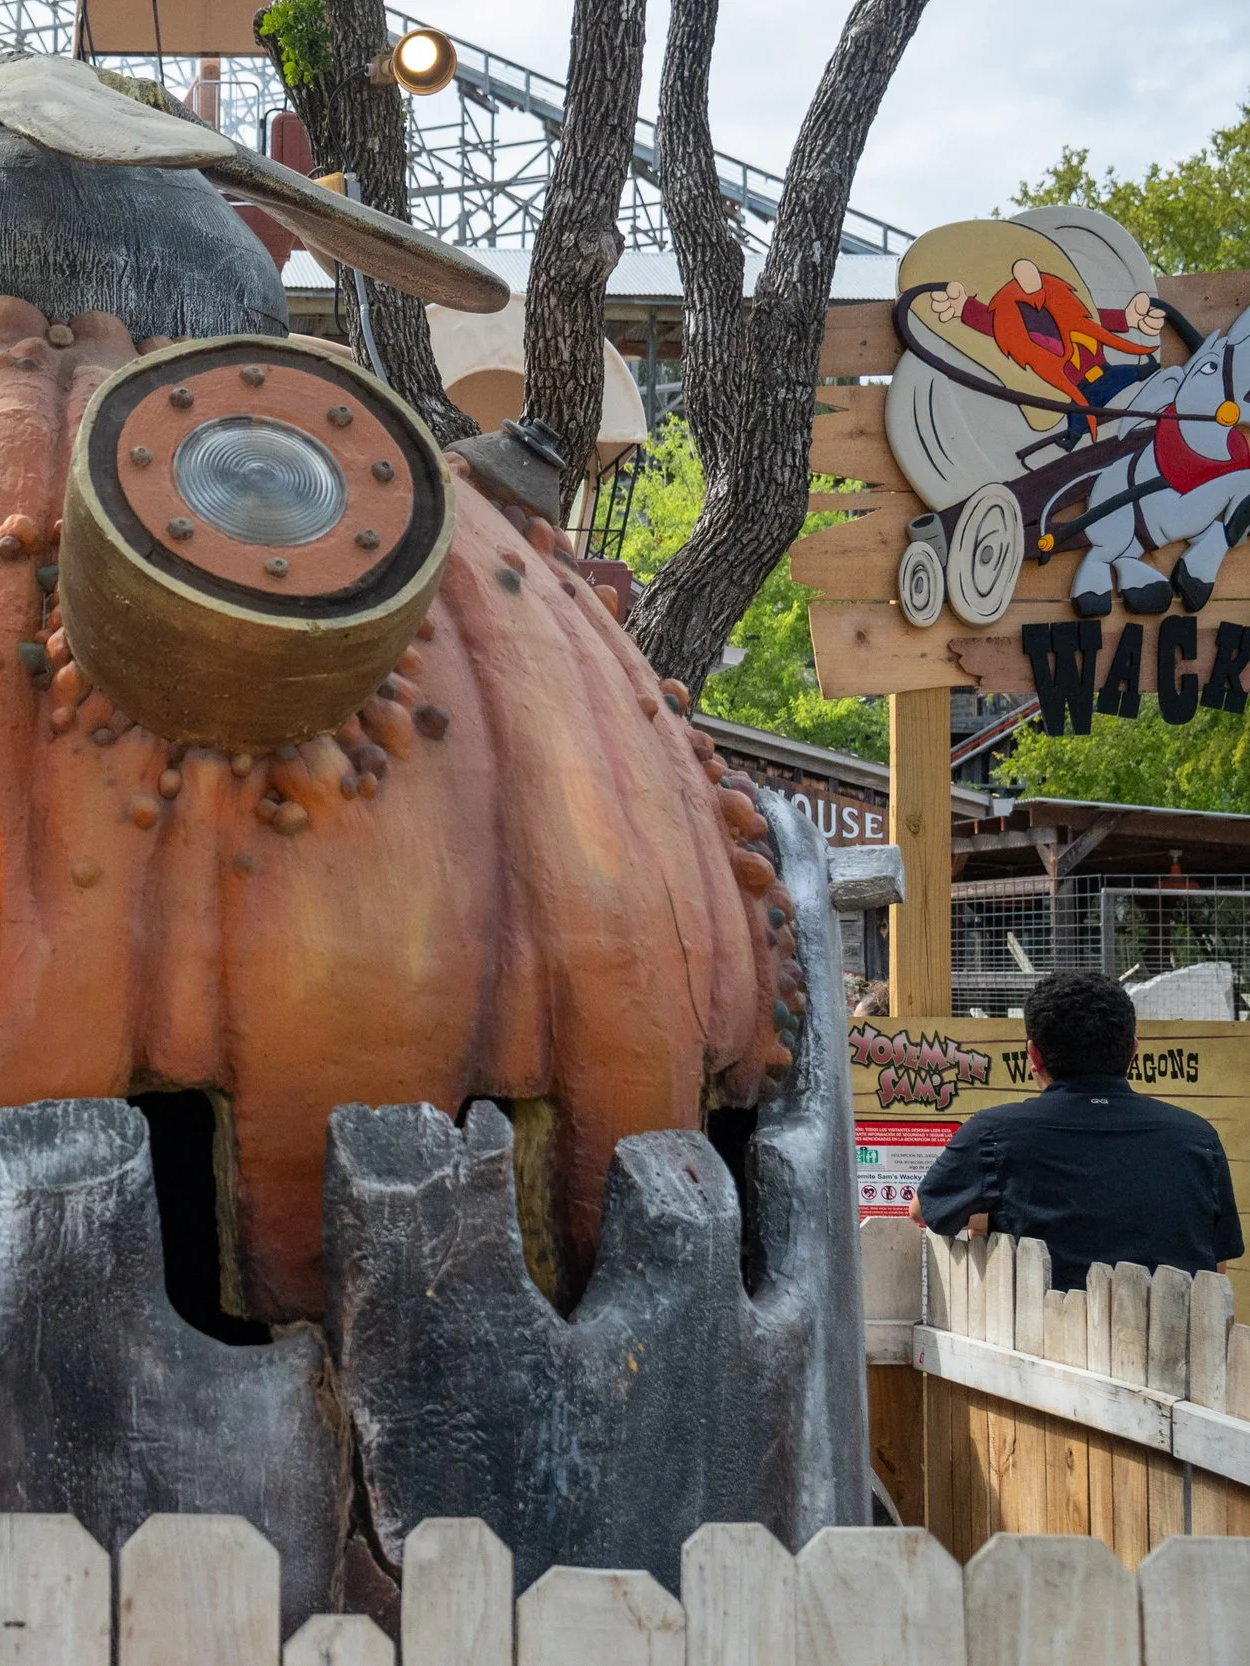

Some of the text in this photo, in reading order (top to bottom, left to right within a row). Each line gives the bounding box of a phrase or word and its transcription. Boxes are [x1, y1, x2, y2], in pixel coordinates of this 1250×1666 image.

[585, 570, 596, 585] 4
[1022, 614, 1250, 737] WACK
[848, 1021, 991, 1085] YOSEMITE
[1127, 1048, 1199, 1083] AGONS
[876, 1065, 959, 1111] SAM'S
